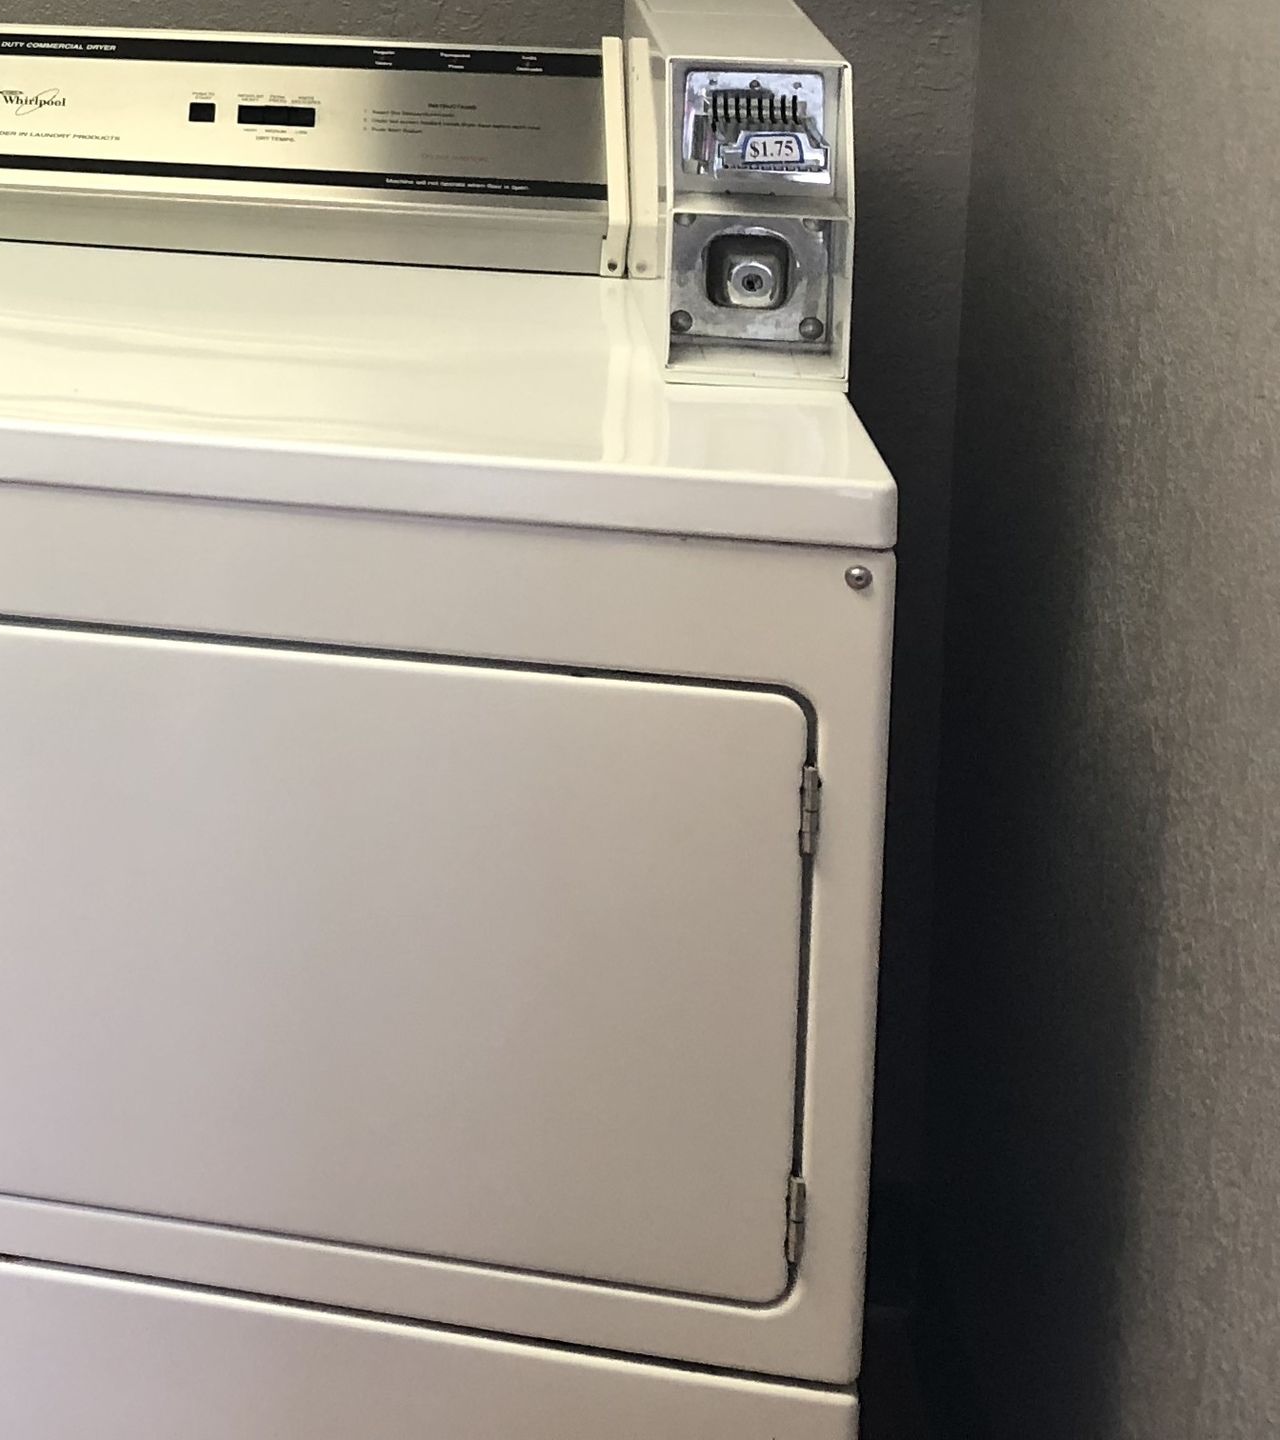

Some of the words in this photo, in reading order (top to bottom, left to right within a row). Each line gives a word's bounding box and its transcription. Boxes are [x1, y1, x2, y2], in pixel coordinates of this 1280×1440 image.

[26, 42, 83, 50] COMMERCIAL
[2, 94, 66, 109] Whirlpool
[749, 139, 794, 159] $1.75
